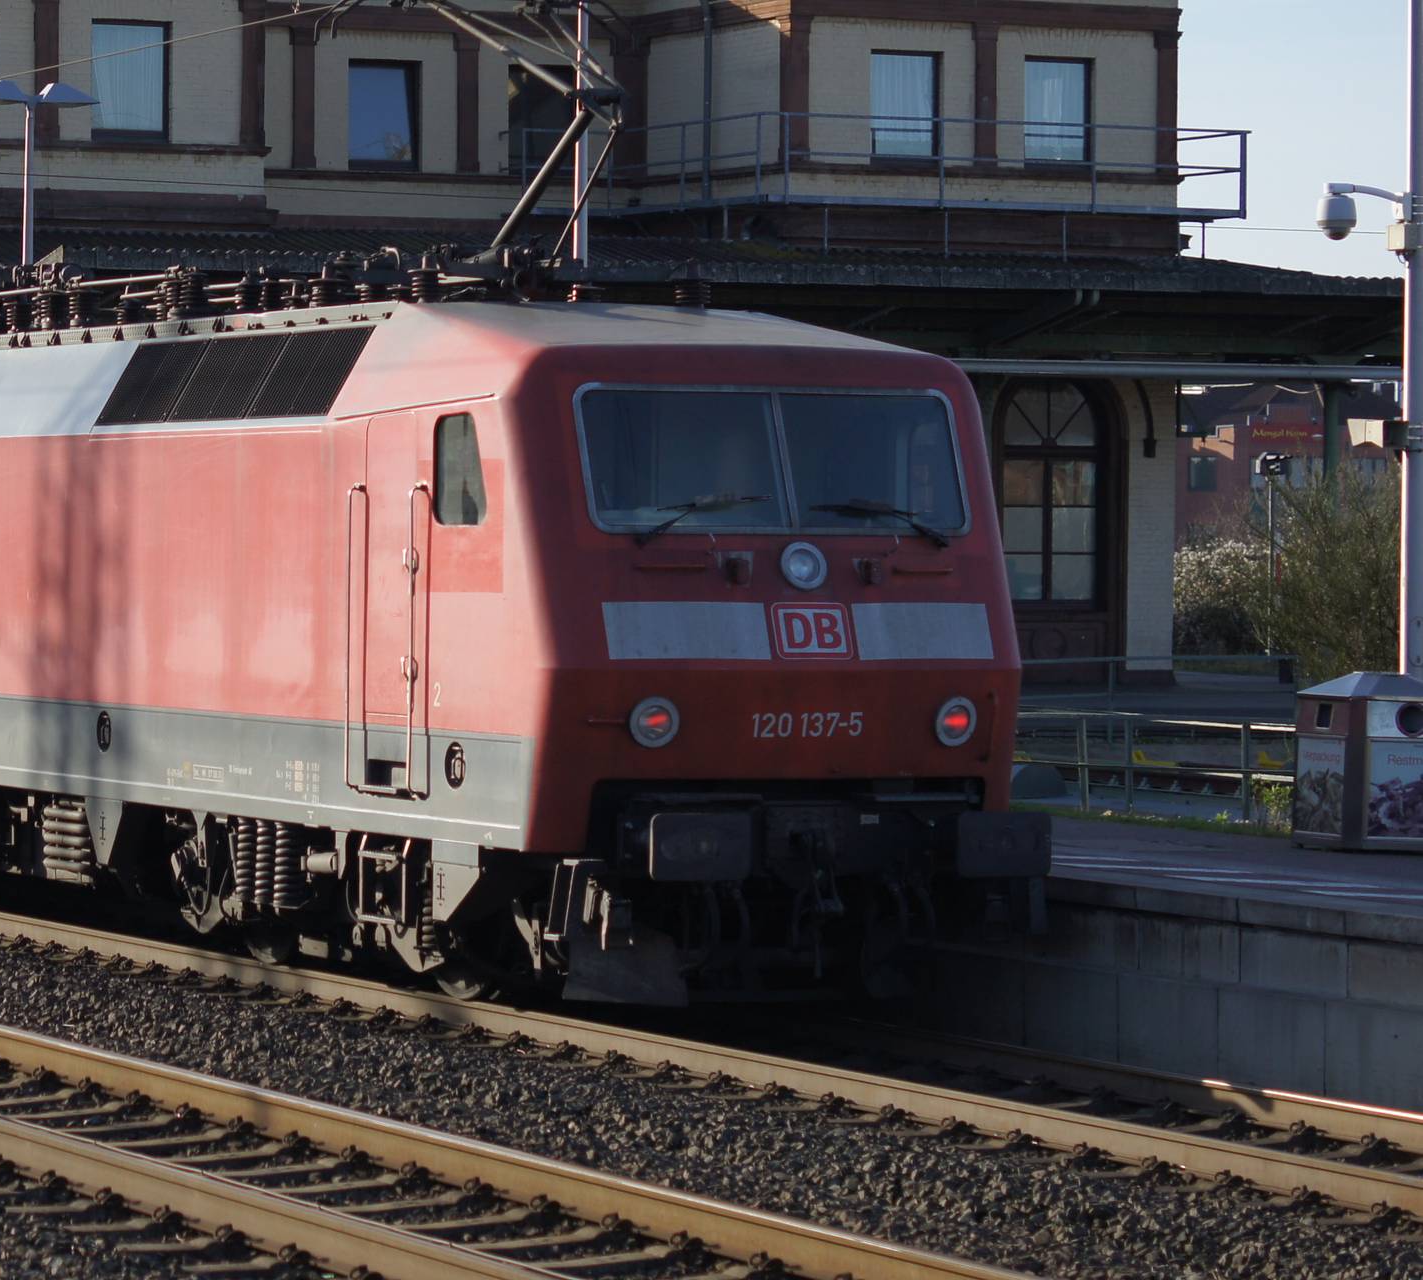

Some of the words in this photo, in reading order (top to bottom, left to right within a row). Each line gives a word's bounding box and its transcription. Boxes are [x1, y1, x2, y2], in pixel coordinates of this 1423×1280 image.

[781, 610, 844, 651] DB
[433, 681, 441, 707] 2
[752, 712, 793, 738] 120
[800, 711, 863, 738] 137-5
